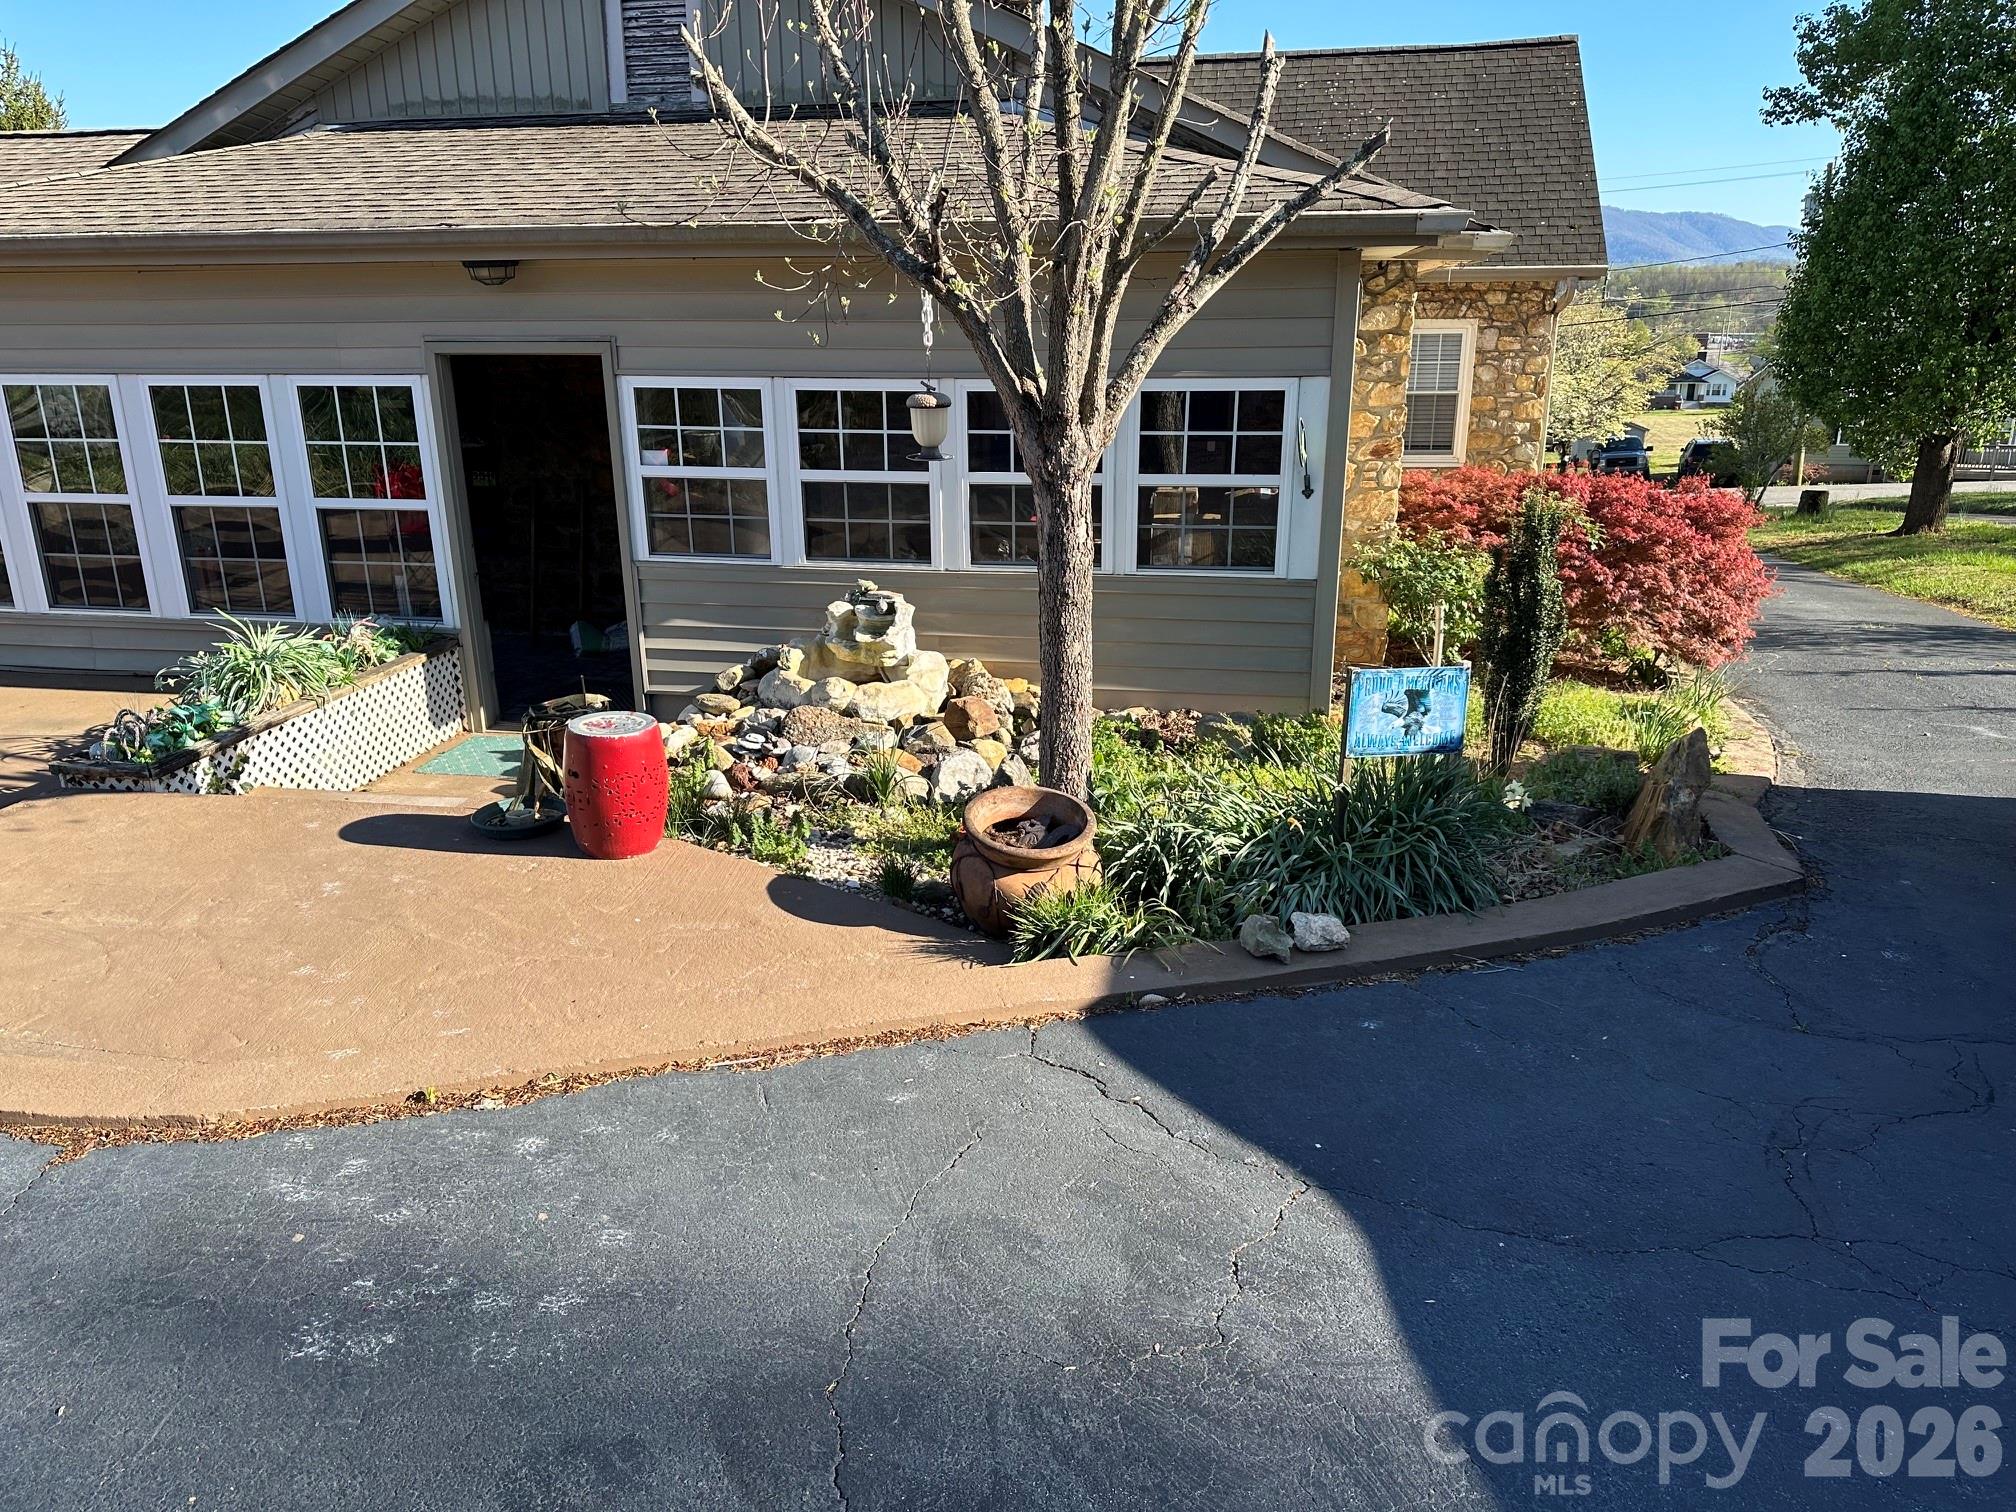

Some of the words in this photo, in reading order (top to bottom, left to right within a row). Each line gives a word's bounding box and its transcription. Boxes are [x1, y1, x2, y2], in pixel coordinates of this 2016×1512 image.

[1355, 675, 1393, 698] PROUD
[1398, 674, 1462, 695] AMERICANS
[1353, 733, 1399, 749] ALWAYS
[1402, 730, 1457, 747] WELCOME
